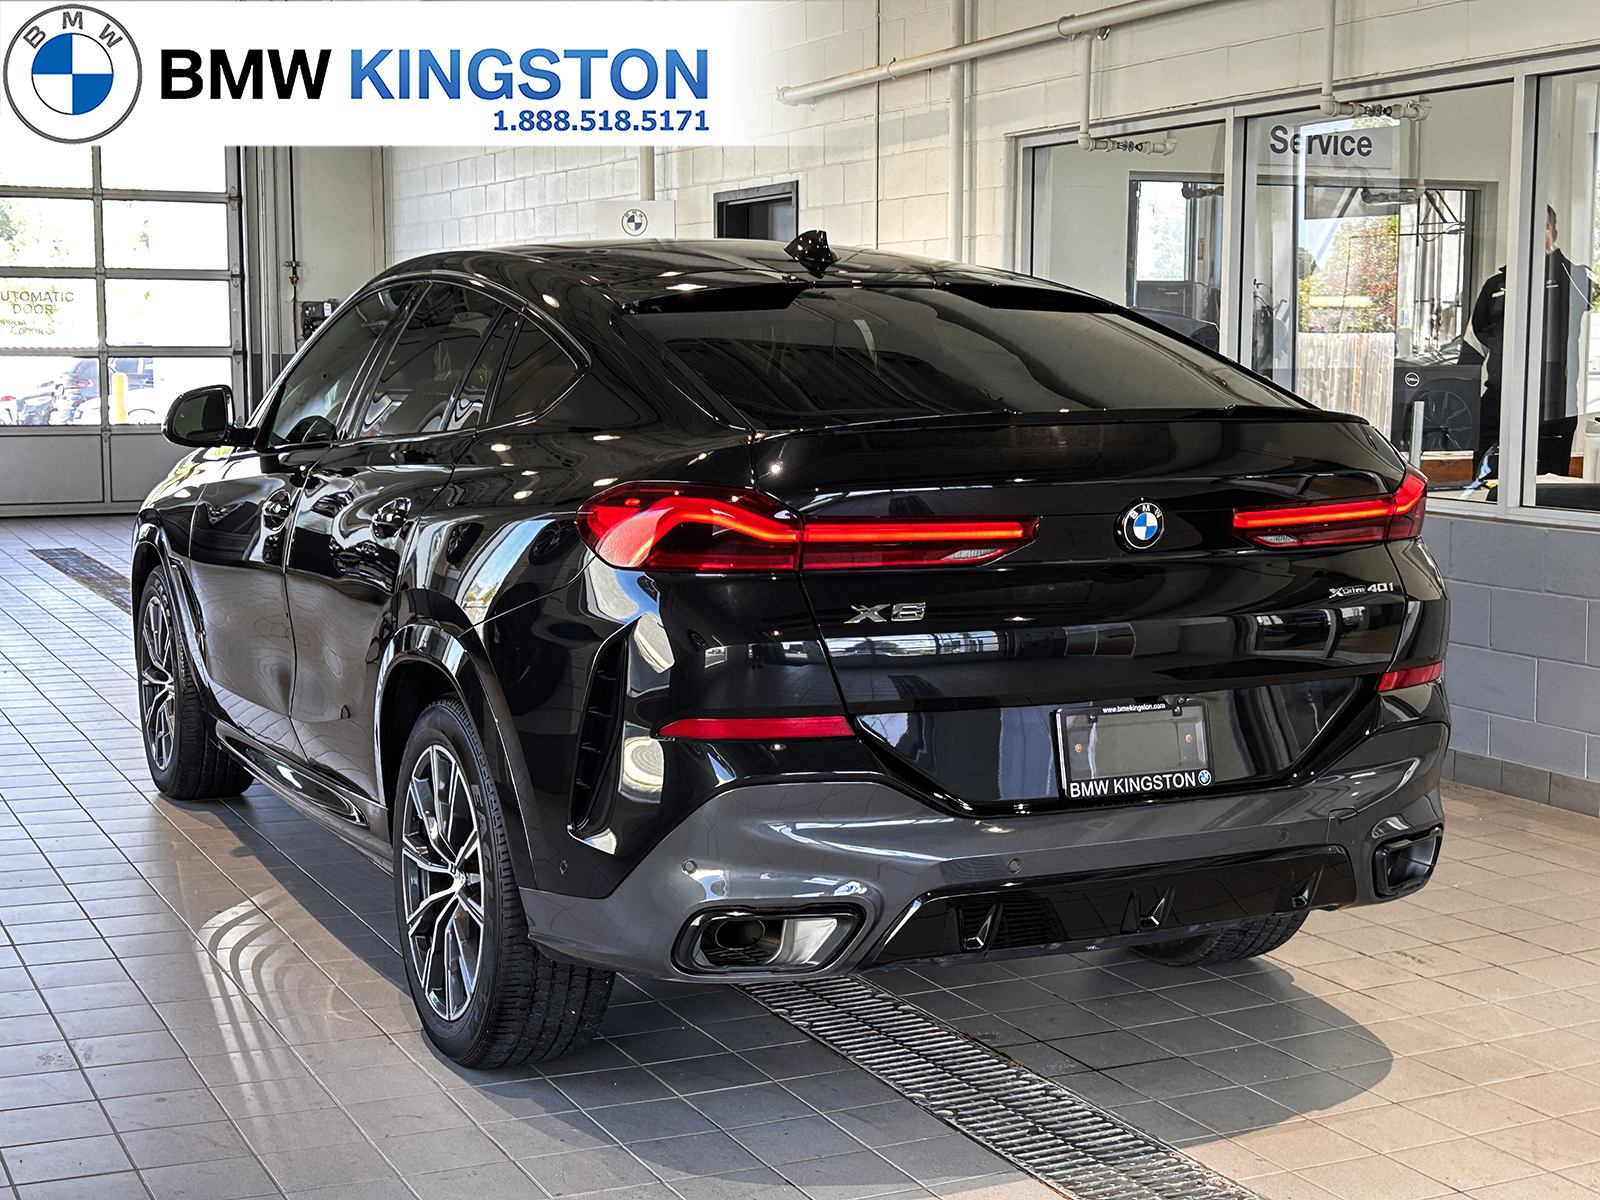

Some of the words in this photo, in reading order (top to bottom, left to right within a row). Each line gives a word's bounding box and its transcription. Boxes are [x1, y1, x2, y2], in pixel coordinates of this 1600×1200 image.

[1269, 125, 1373, 157] Service
[0, 290, 74, 302] UTOMATIC
[13, 303, 54, 314] DOOR
[1129, 504, 1162, 519] BMW
[843, 602, 926, 624] X6
[1069, 780, 1109, 798] BMW
[1113, 771, 1196, 794] KINGSTON
